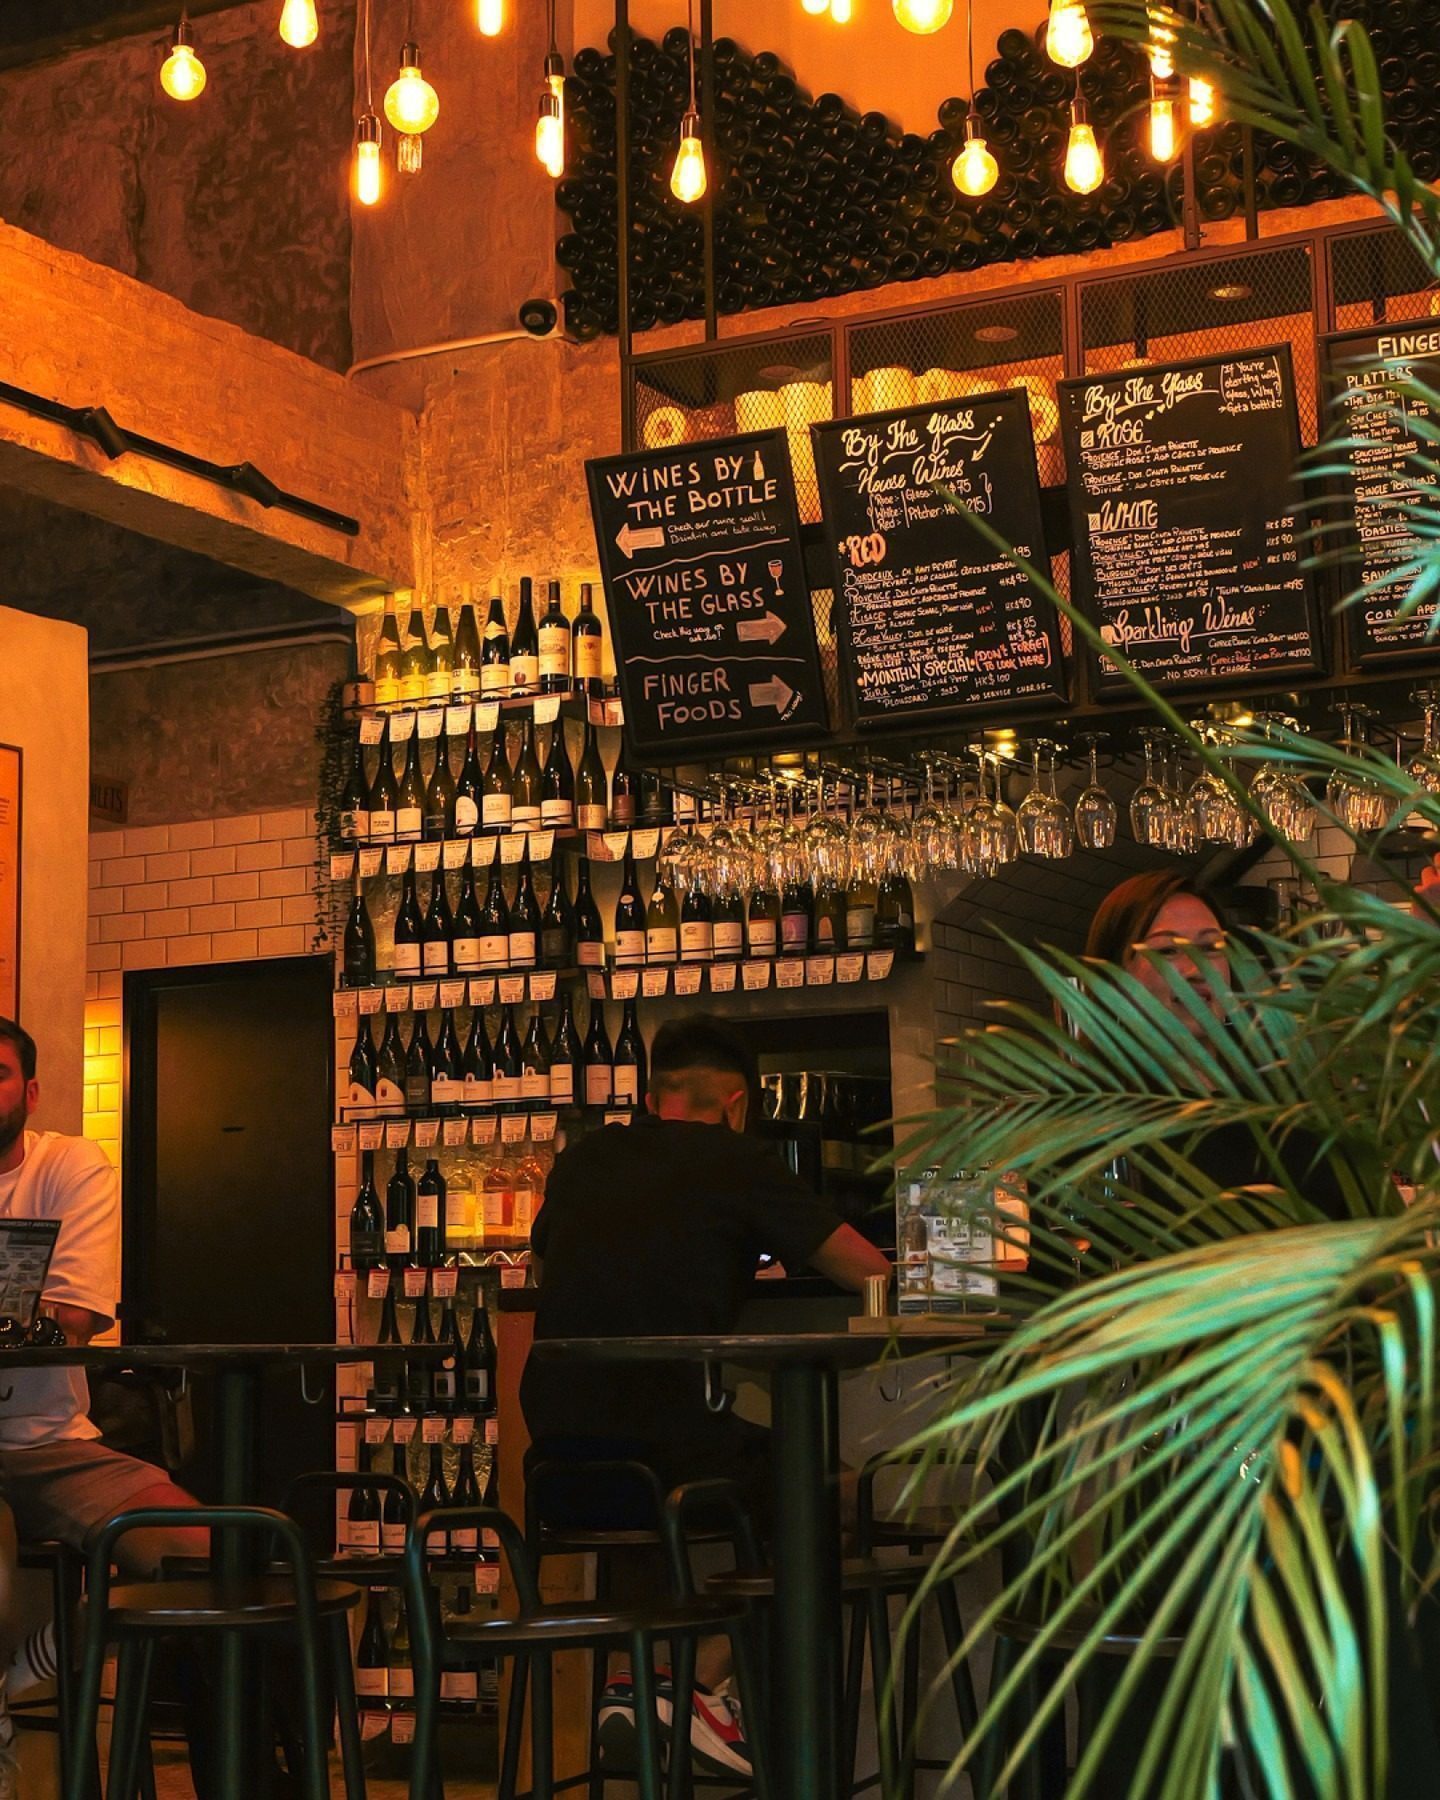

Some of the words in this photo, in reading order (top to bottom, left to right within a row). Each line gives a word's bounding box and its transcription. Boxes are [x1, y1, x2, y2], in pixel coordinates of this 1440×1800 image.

[1378, 332, 1440, 358] FINGE
[1346, 366, 1414, 389] PLATTERS
[1085, 384, 1121, 424] By
[1125, 377, 1154, 406] The
[1160, 371, 1204, 410] Glass
[841, 427, 884, 466] By
[886, 419, 919, 451] The
[926, 409, 977, 454] Glass
[714, 456, 744, 482] BY
[858, 465, 908, 494] House
[911, 449, 965, 485] Wines
[627, 495, 677, 522] THE
[687, 479, 778, 513] BOTTLE
[1100, 500, 1159, 531] WHITE
[667, 519, 695, 534] Check
[1281, 516, 1295, 528] 85
[846, 532, 887, 567] RED
[1280, 533, 1293, 545] 90
[624, 567, 708, 600] WINES
[718, 561, 748, 586] BY
[645, 597, 693, 625] THE
[700, 586, 765, 616] GLASS
[1417, 603, 1440, 616] APE
[1112, 605, 1194, 654] Sparkling
[1202, 595, 1256, 631] Wines
[643, 666, 731, 701] FINGER
[862, 662, 922, 688] MONTHLY
[923, 656, 974, 677] SPECIAL
